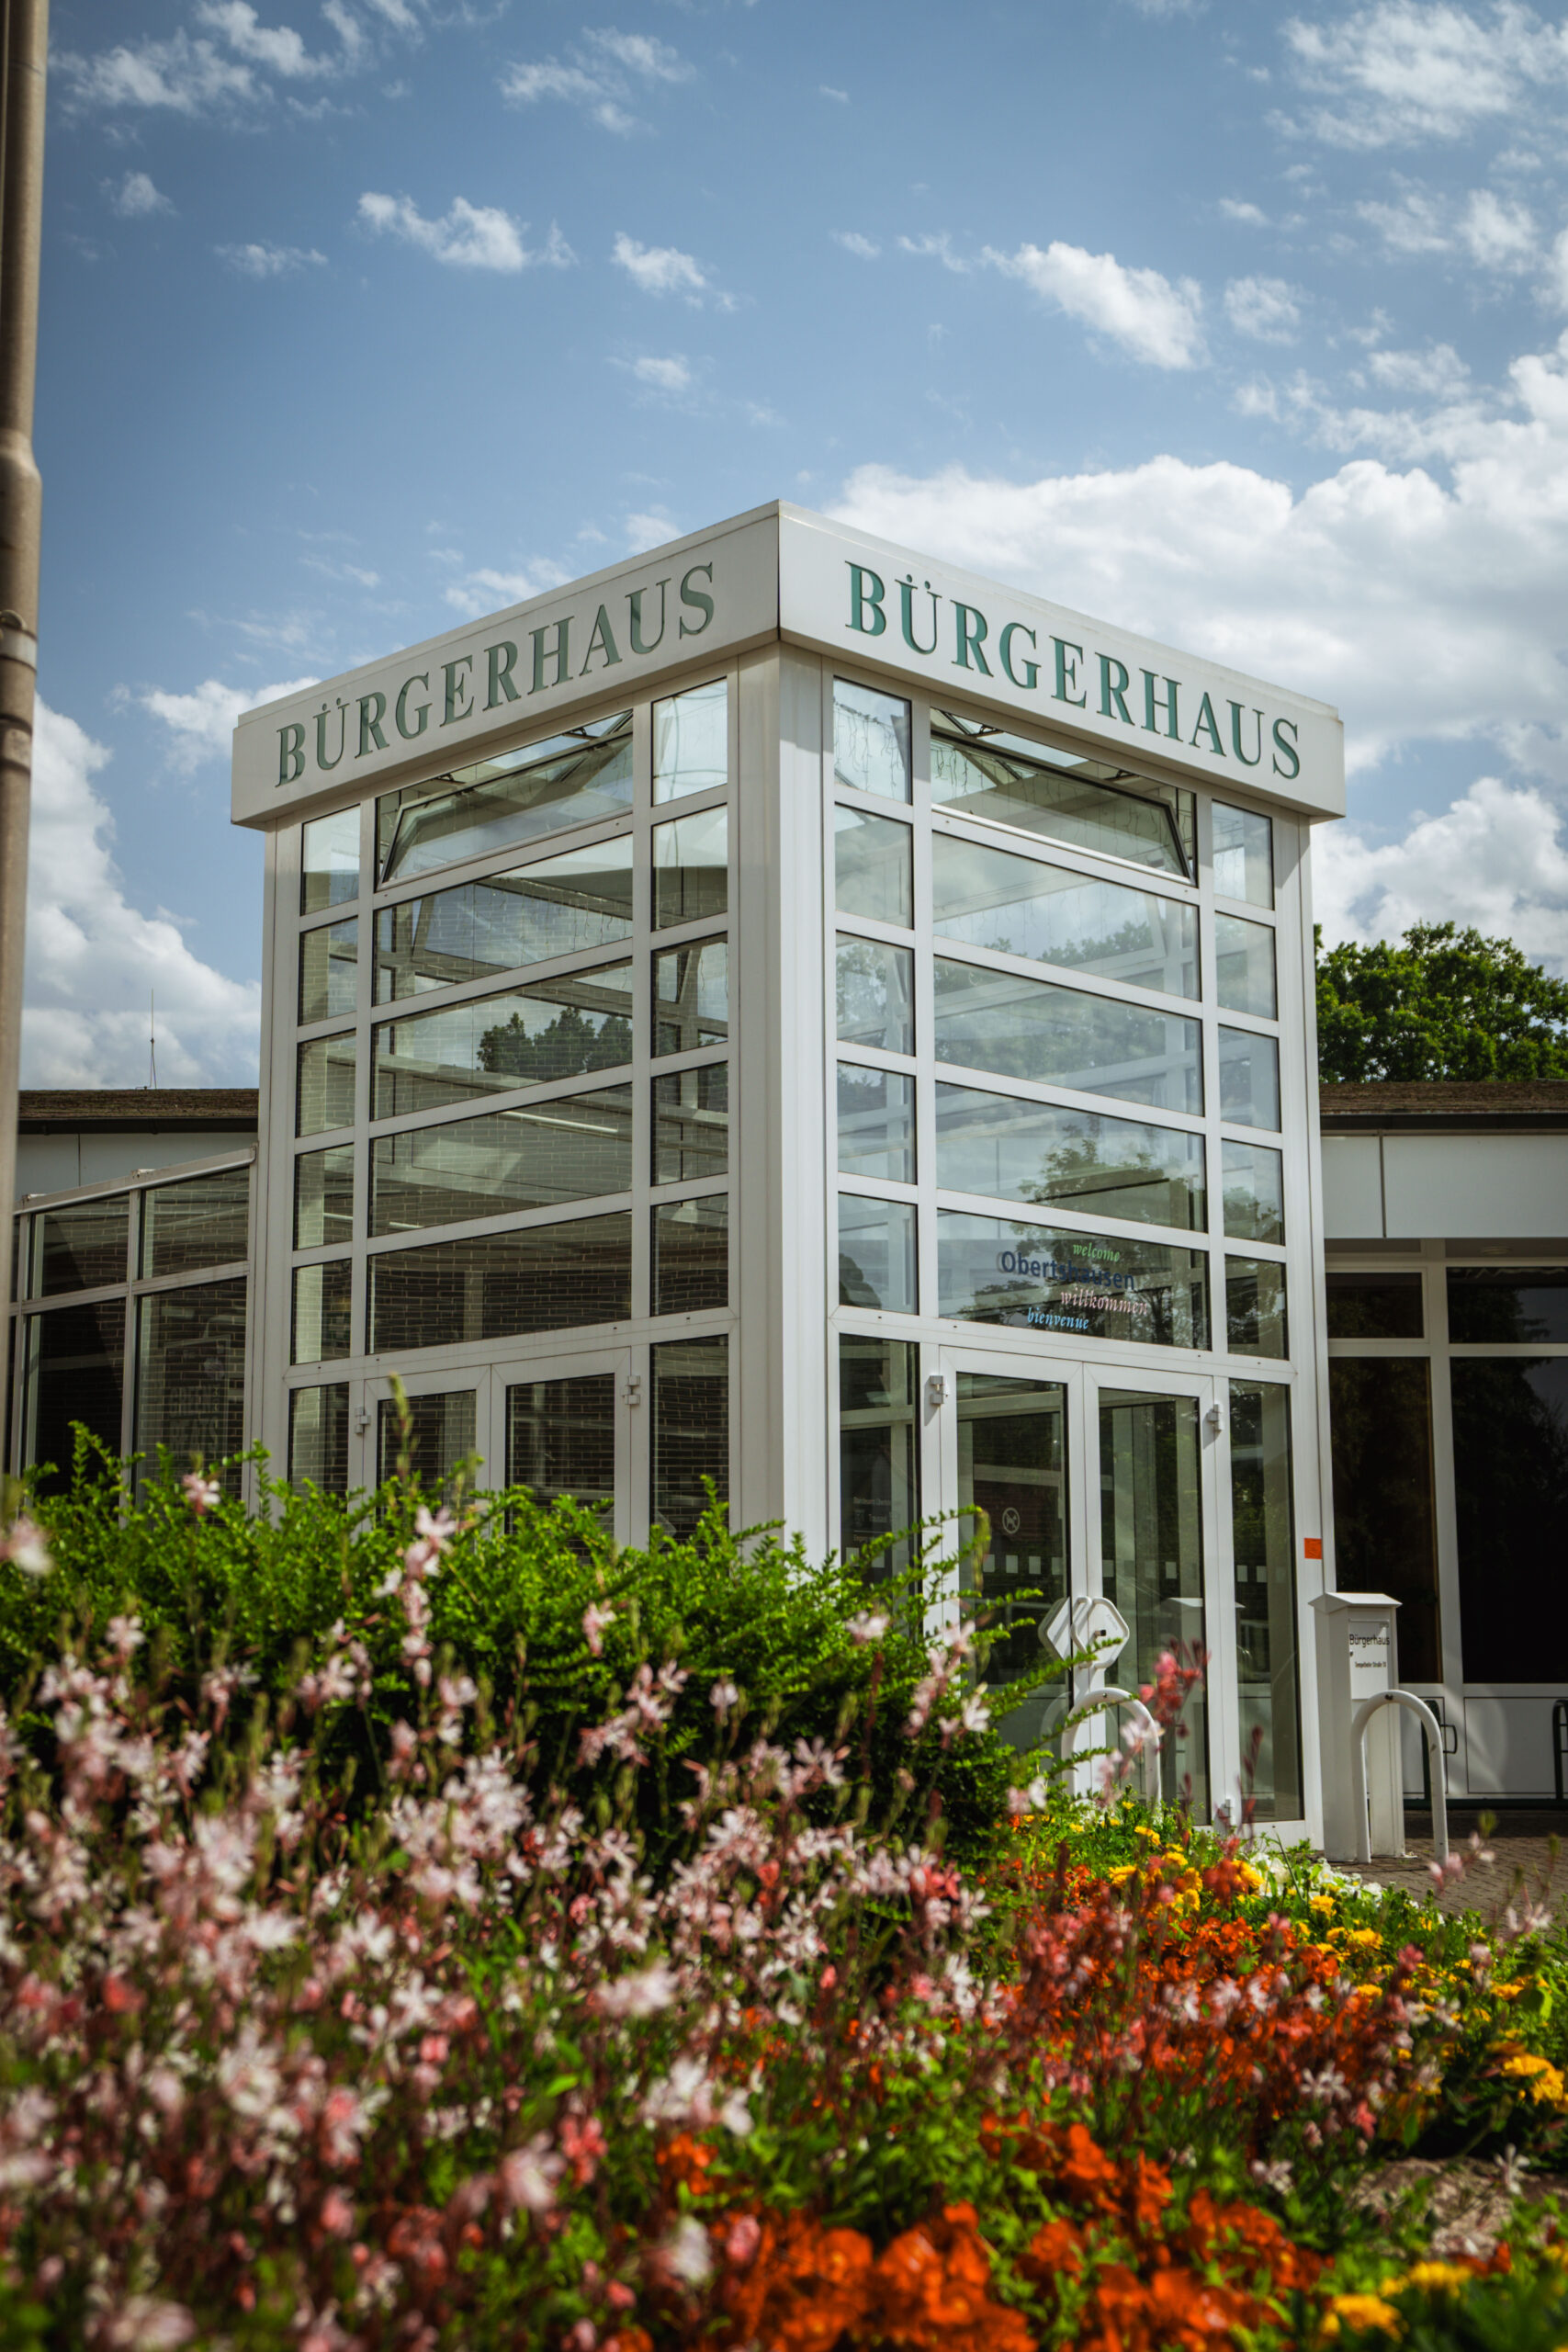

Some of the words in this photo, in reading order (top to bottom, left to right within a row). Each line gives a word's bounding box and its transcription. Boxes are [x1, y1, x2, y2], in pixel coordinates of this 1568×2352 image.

[275, 560, 715, 788] BÜRGERHAUS
[844, 560, 1301, 780] BÜRGERHAUS
[1072, 1242, 1121, 1262] welcome
[1001, 1250, 1134, 1290] Obertshausen
[1060, 1287, 1148, 1316] willkommen
[1027, 1306, 1089, 1329] bienvenue
[1349, 1634, 1390, 1647] Bürgerhaus
